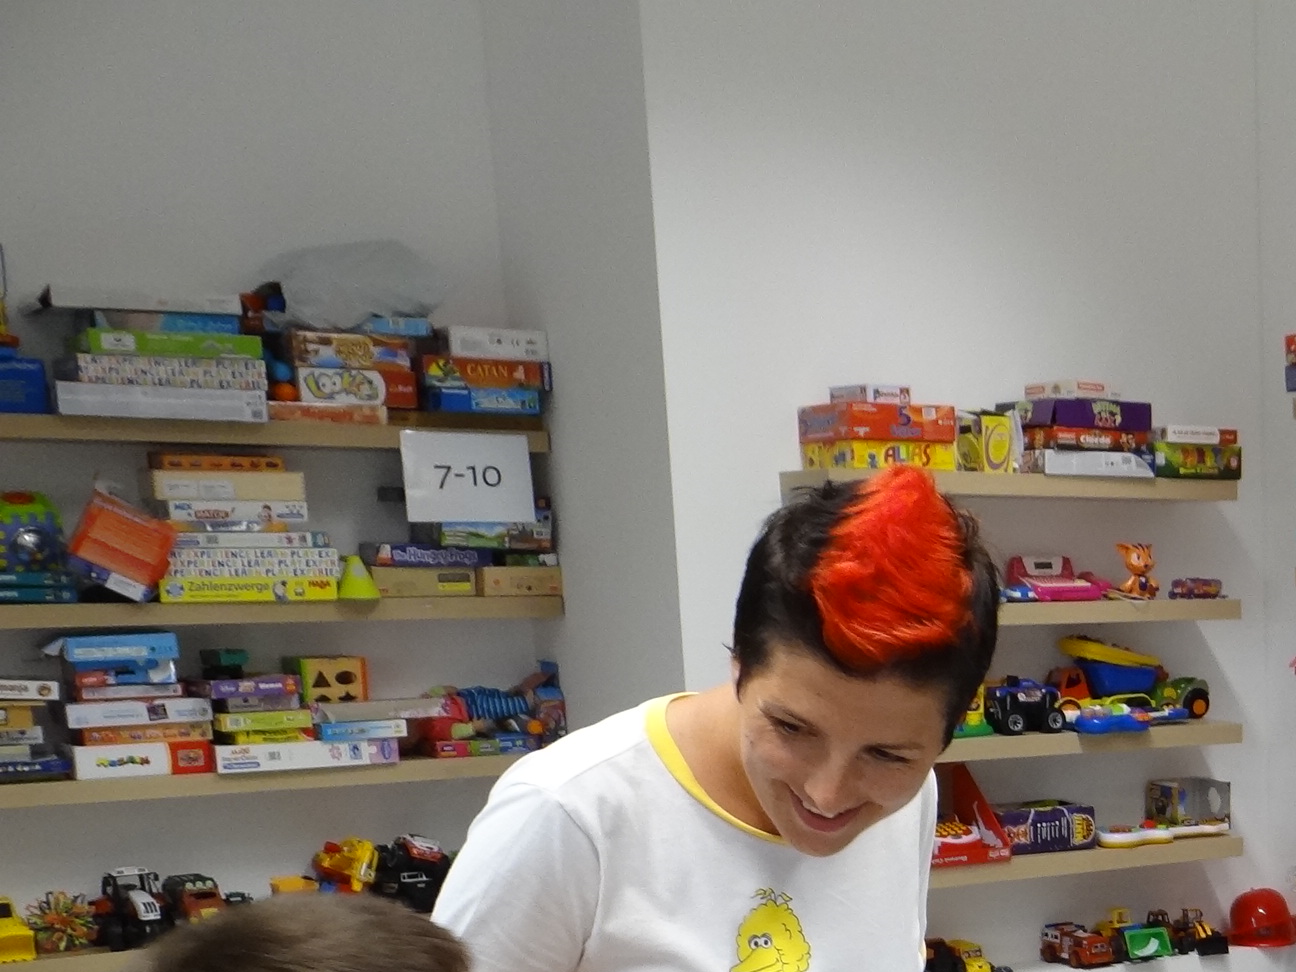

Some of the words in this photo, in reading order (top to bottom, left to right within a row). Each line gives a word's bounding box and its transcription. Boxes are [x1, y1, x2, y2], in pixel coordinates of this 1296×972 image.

[466, 362, 508, 378] CATAN
[434, 465, 502, 490] 7-10
[187, 580, 271, 593] Zahlenzwerge
